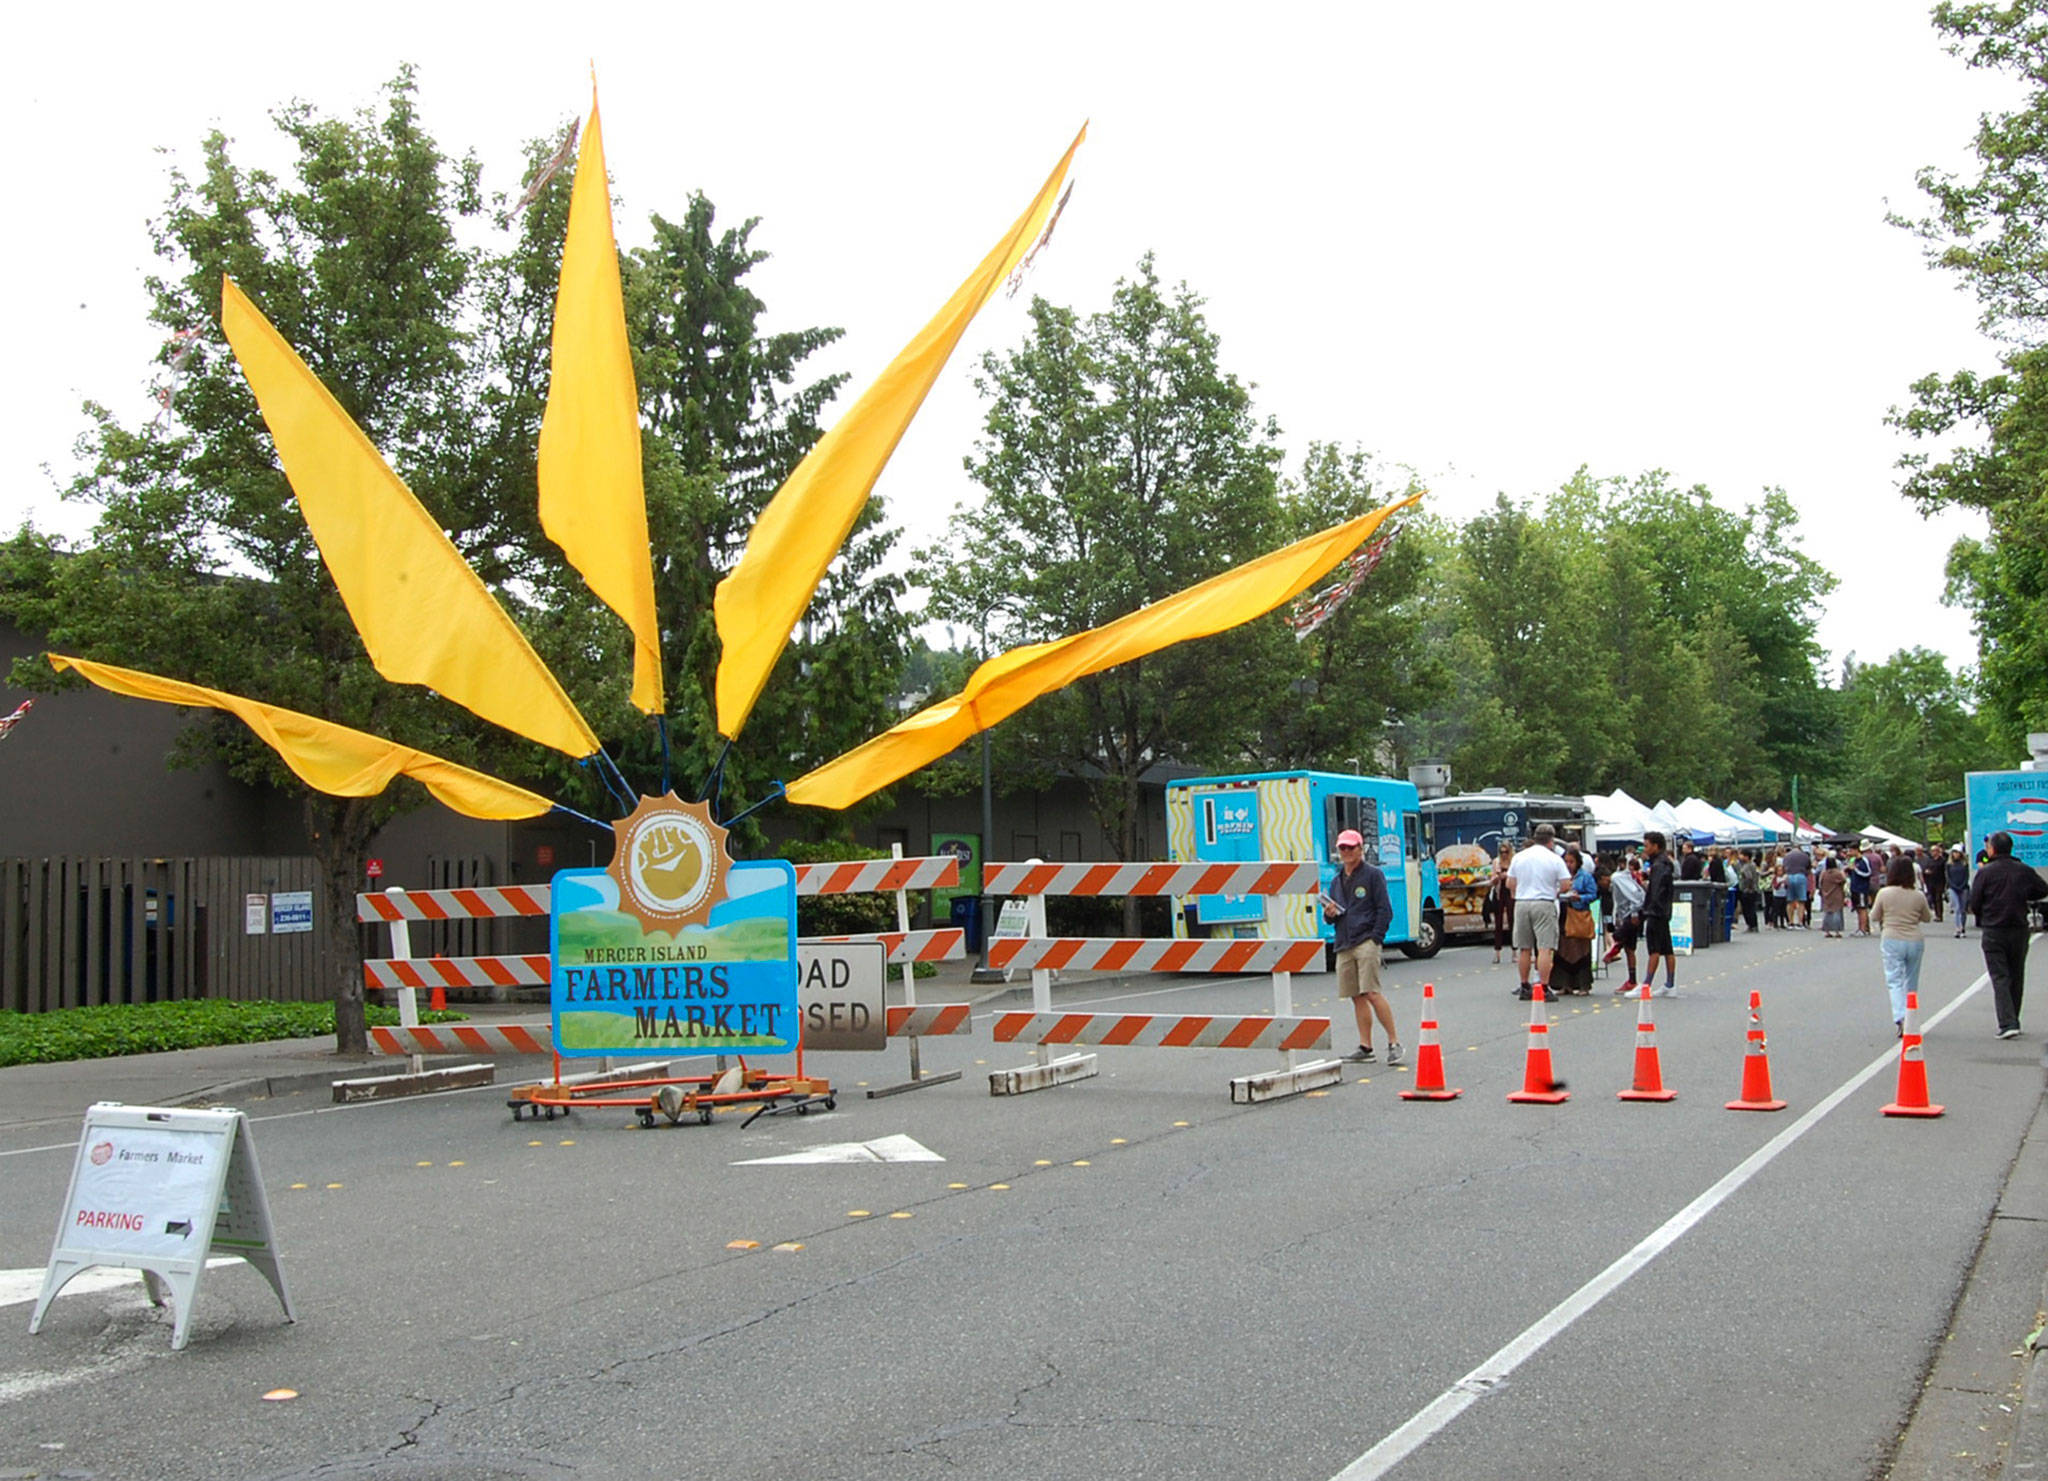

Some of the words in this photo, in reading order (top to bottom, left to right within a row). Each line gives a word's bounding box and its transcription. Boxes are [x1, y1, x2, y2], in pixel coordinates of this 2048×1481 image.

[584, 947, 646, 963] MERCER
[651, 945, 707, 961] ISLAND
[566, 966, 729, 1001] FARMERS
[797, 957, 850, 988] AD
[634, 1003, 780, 1039] MARKET
[798, 1002, 870, 1033] SED
[119, 1149, 159, 1162] Farmers
[167, 1152, 204, 1165] Market
[76, 1210, 144, 1231] PARKING
